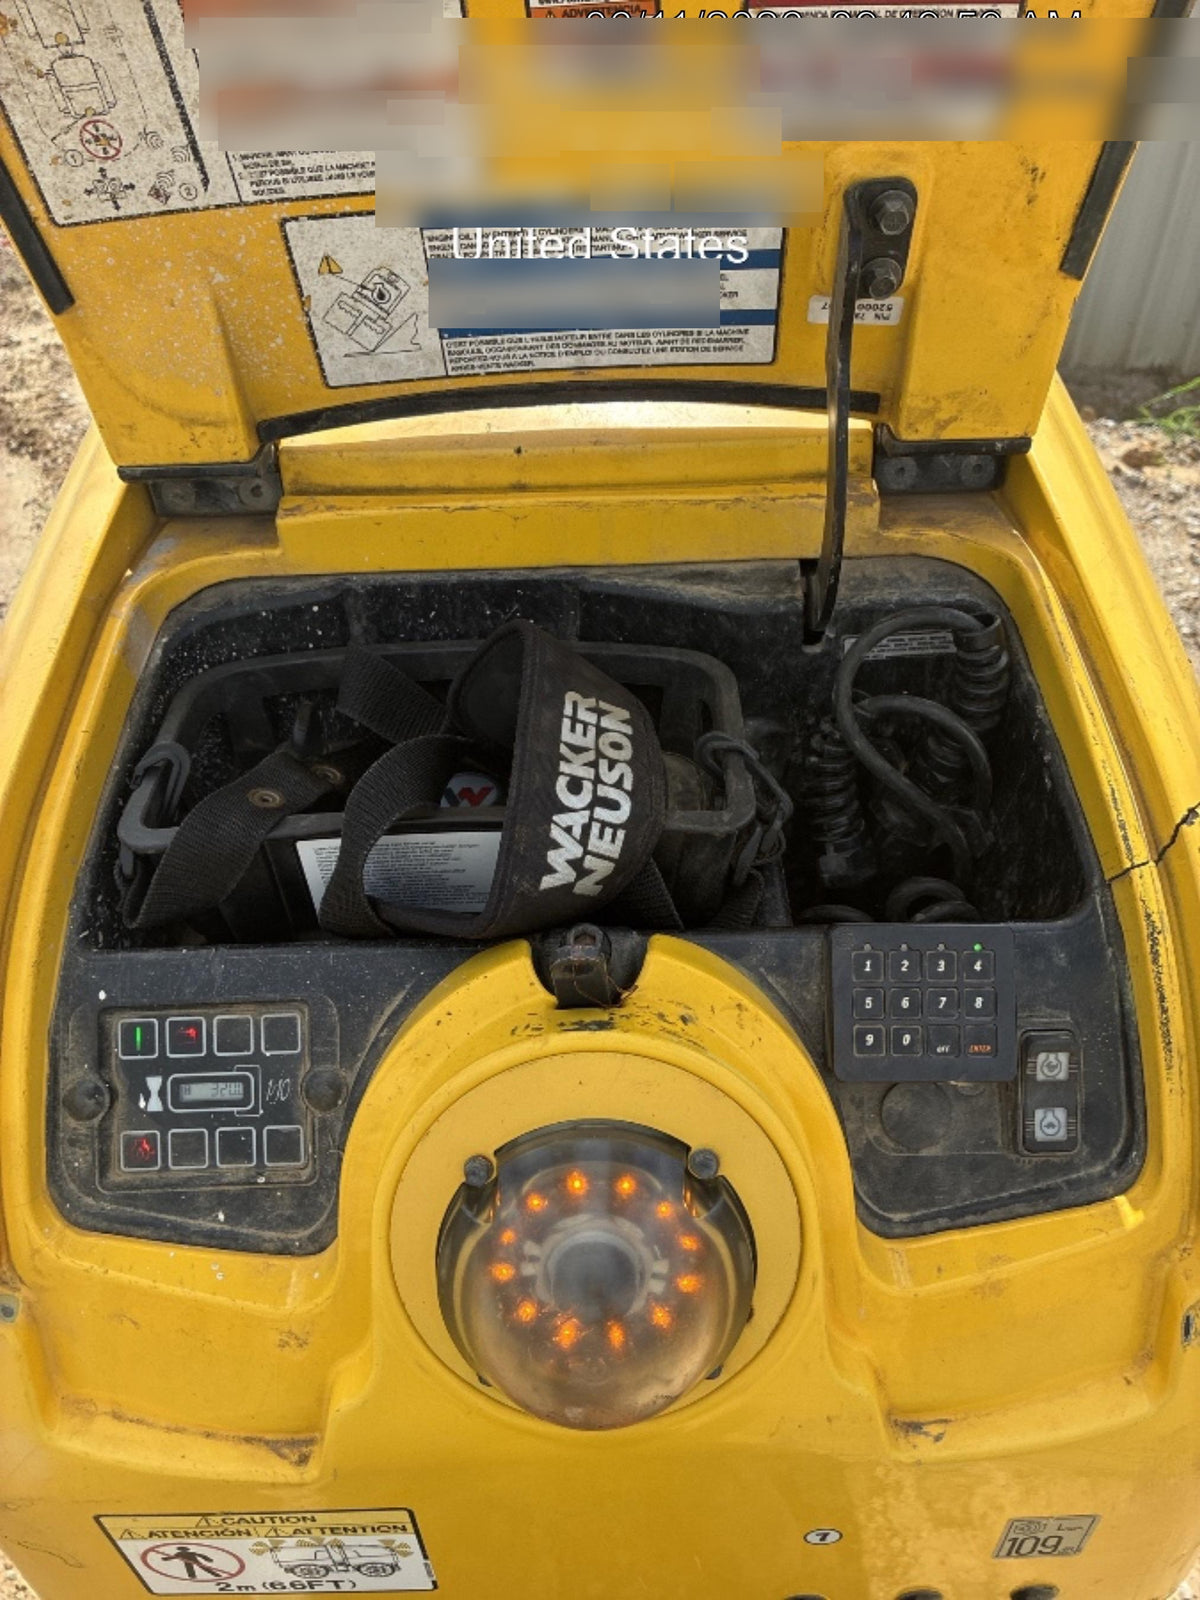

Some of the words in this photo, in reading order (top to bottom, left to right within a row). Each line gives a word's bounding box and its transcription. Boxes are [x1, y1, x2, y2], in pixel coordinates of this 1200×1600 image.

[539, 690, 598, 892] WACKER
[573, 700, 634, 897] NEUSON
[864, 960, 872, 972] 1
[901, 960, 909, 972] 2
[937, 960, 945, 972] 3
[973, 960, 982, 972] 4
[865, 997, 873, 1009] 5
[901, 997, 910, 1009] 6
[938, 997, 947, 1009] 7
[974, 997, 983, 1009] 8
[865, 1034, 874, 1046] 9
[902, 1034, 911, 1046] 0
[221, 1515, 318, 1525] CAUTION
[148, 1527, 252, 1539] ATENCIÓN
[290, 1524, 408, 1537] ATTENTION
[1005, 1535, 1064, 1557] 109
